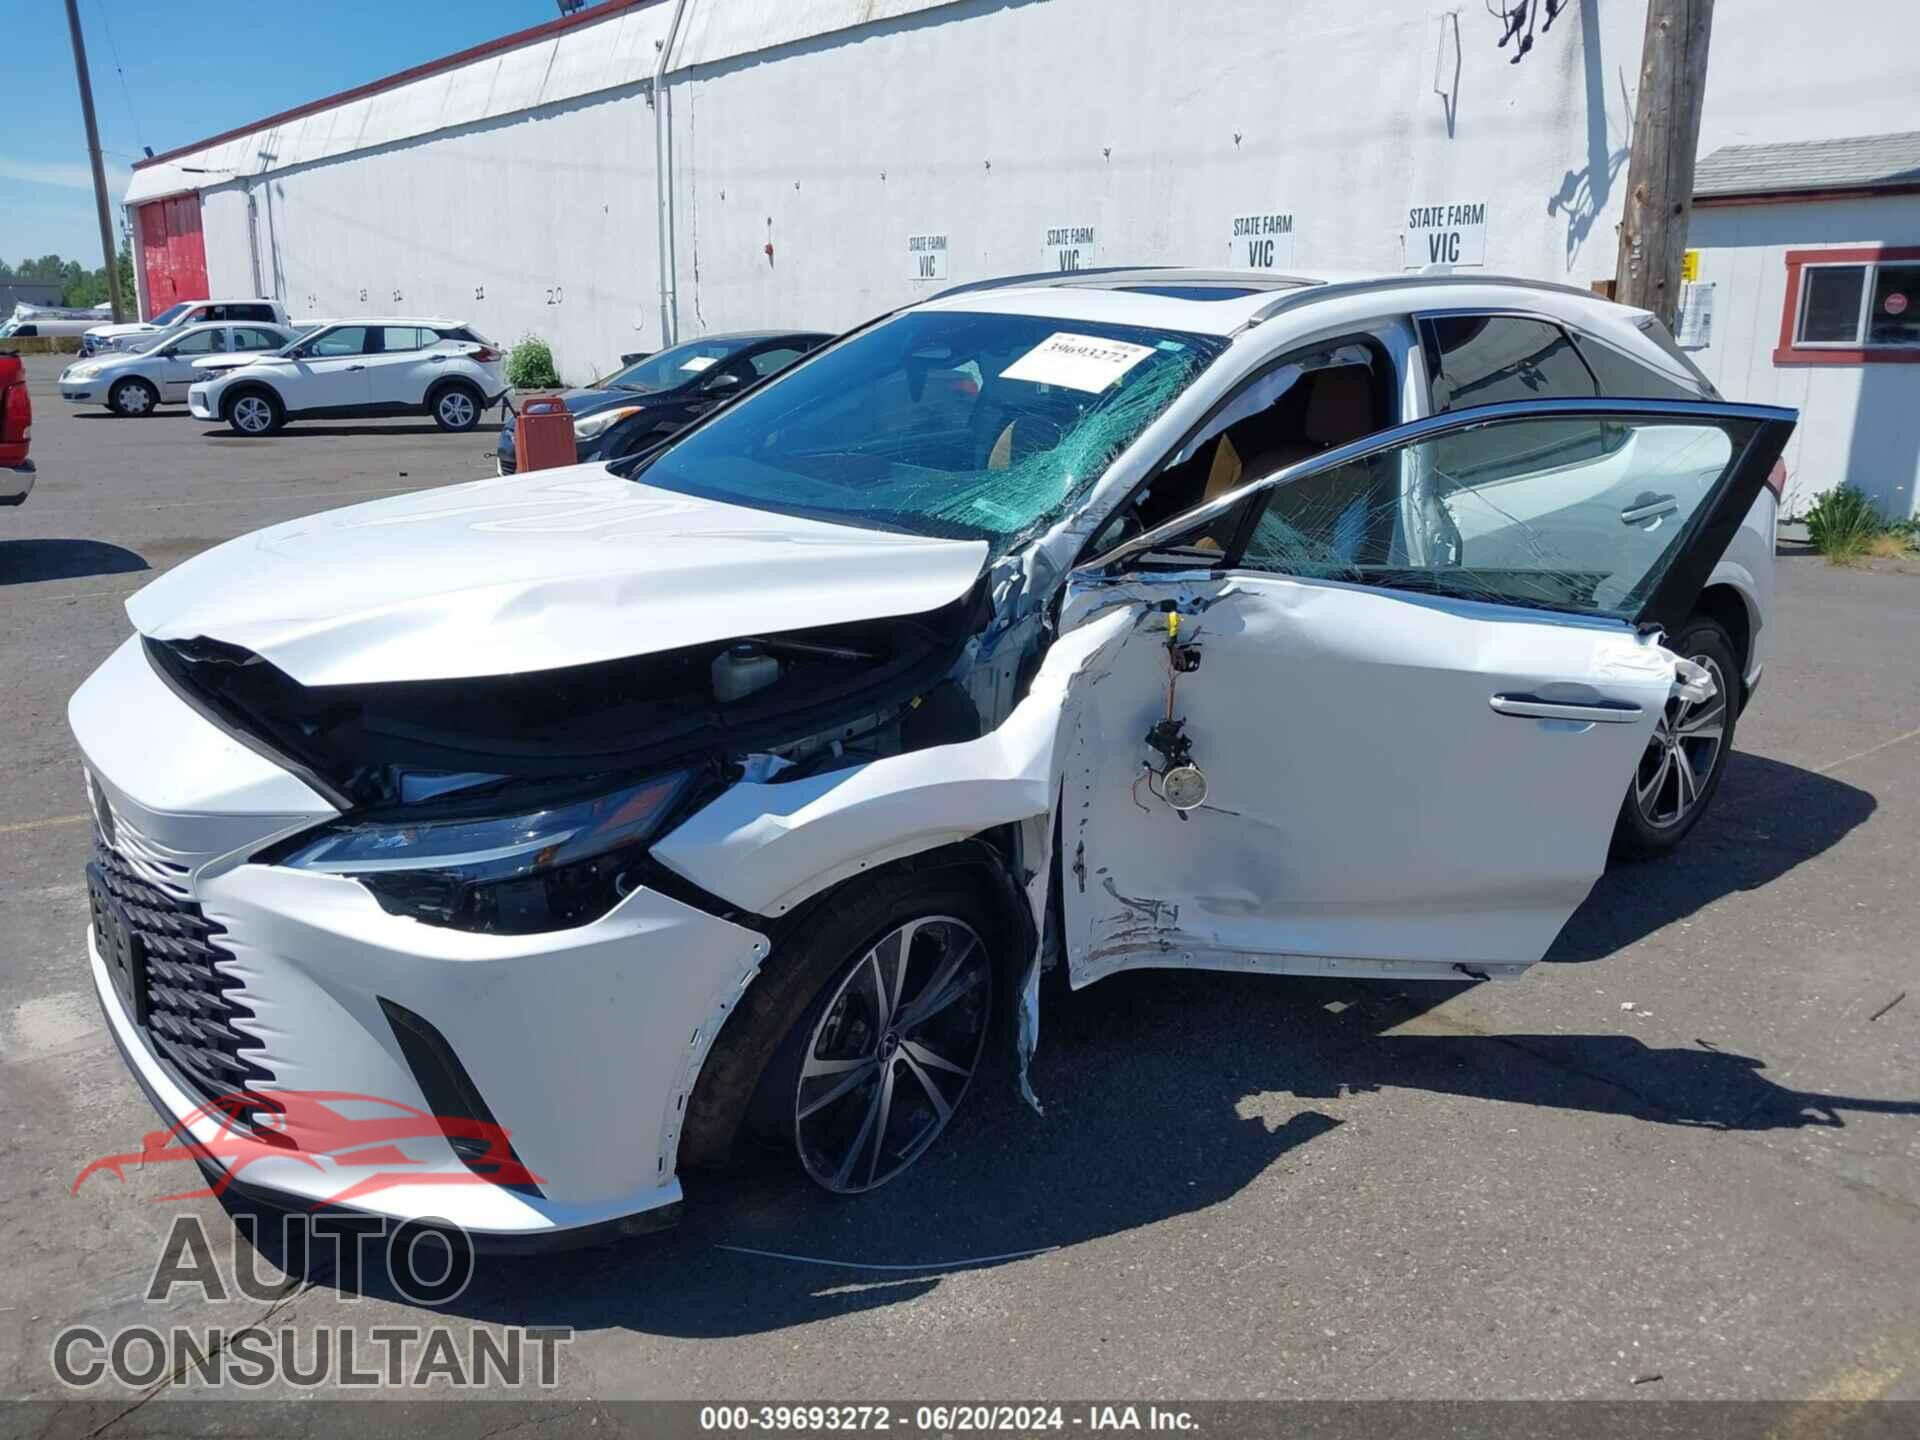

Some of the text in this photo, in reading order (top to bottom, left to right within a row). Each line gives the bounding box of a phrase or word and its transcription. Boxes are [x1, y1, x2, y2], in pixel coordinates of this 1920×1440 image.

[1233, 214, 1293, 237] STATE FARM
[1409, 203, 1485, 229] STATE FARM
[909, 235, 947, 251] STATE FARM
[1047, 227, 1095, 246] STATE FARM
[1428, 232, 1461, 264] VIC
[1059, 249, 1080, 272] VIC
[1248, 239, 1274, 268] VIC
[919, 255, 936, 277] VIC
[546, 286, 564, 304] 20
